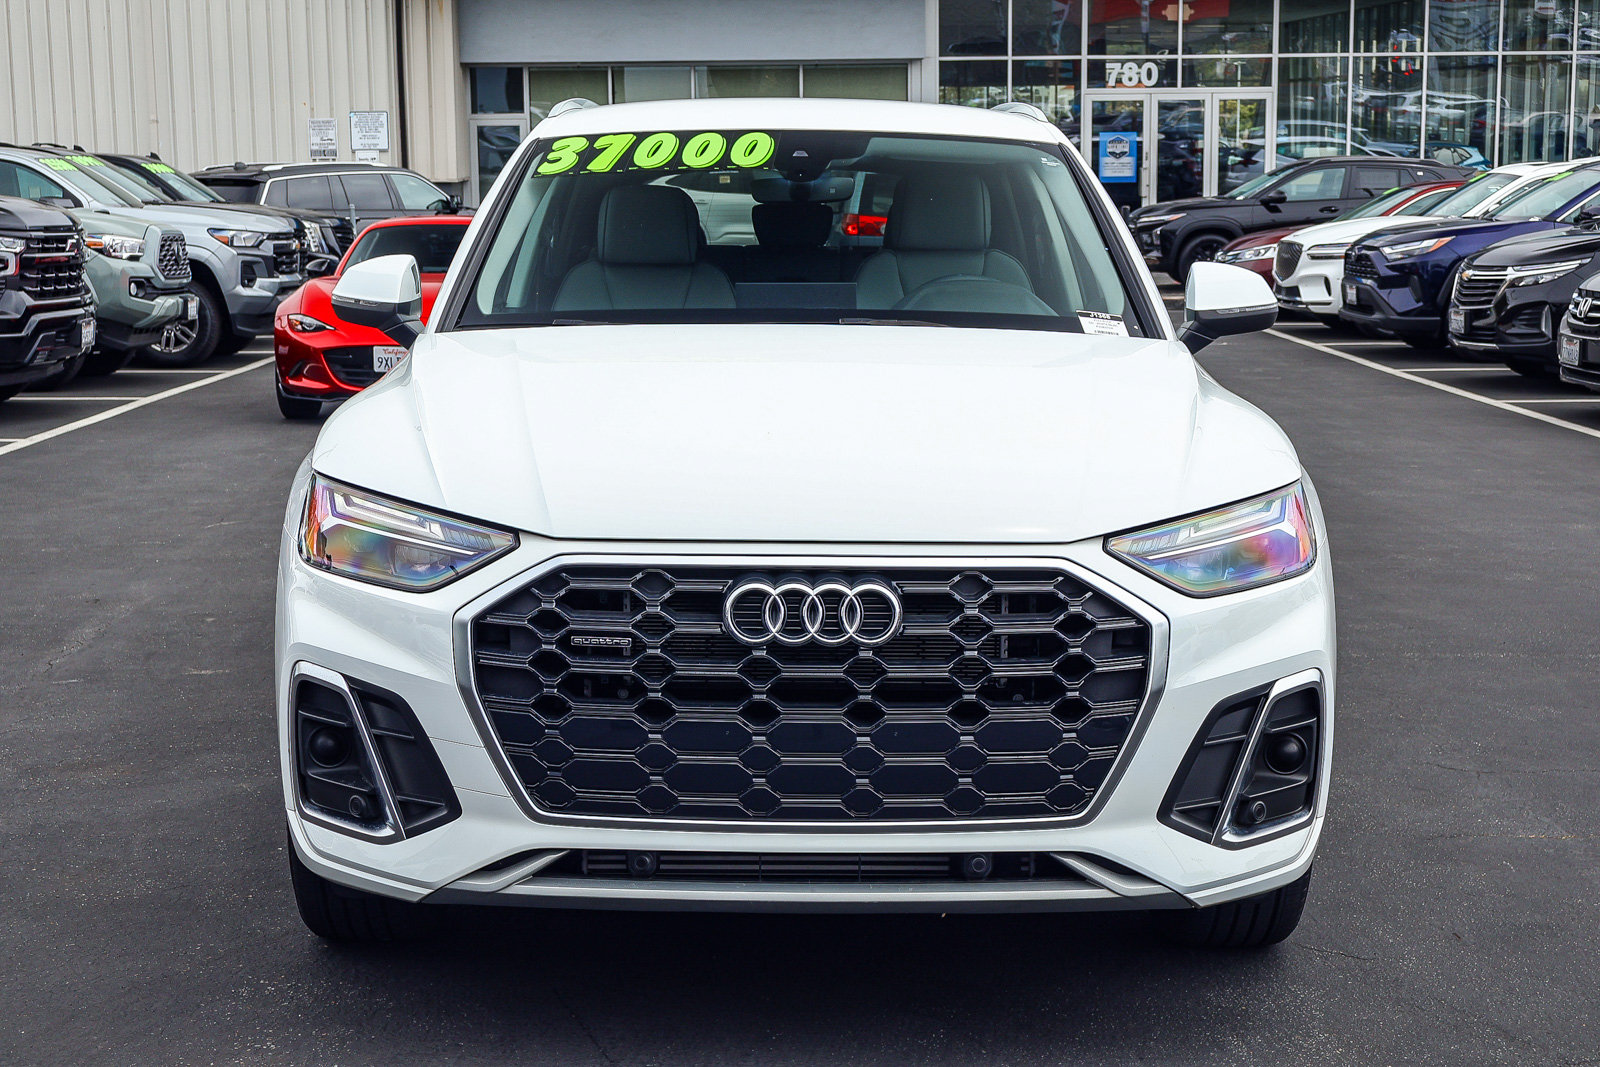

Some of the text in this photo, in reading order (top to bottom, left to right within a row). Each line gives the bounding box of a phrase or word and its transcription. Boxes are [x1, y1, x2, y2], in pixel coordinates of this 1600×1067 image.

[1105, 61, 1159, 87] 780
[537, 132, 775, 175] 37000
[573, 637, 629, 645] quattro
